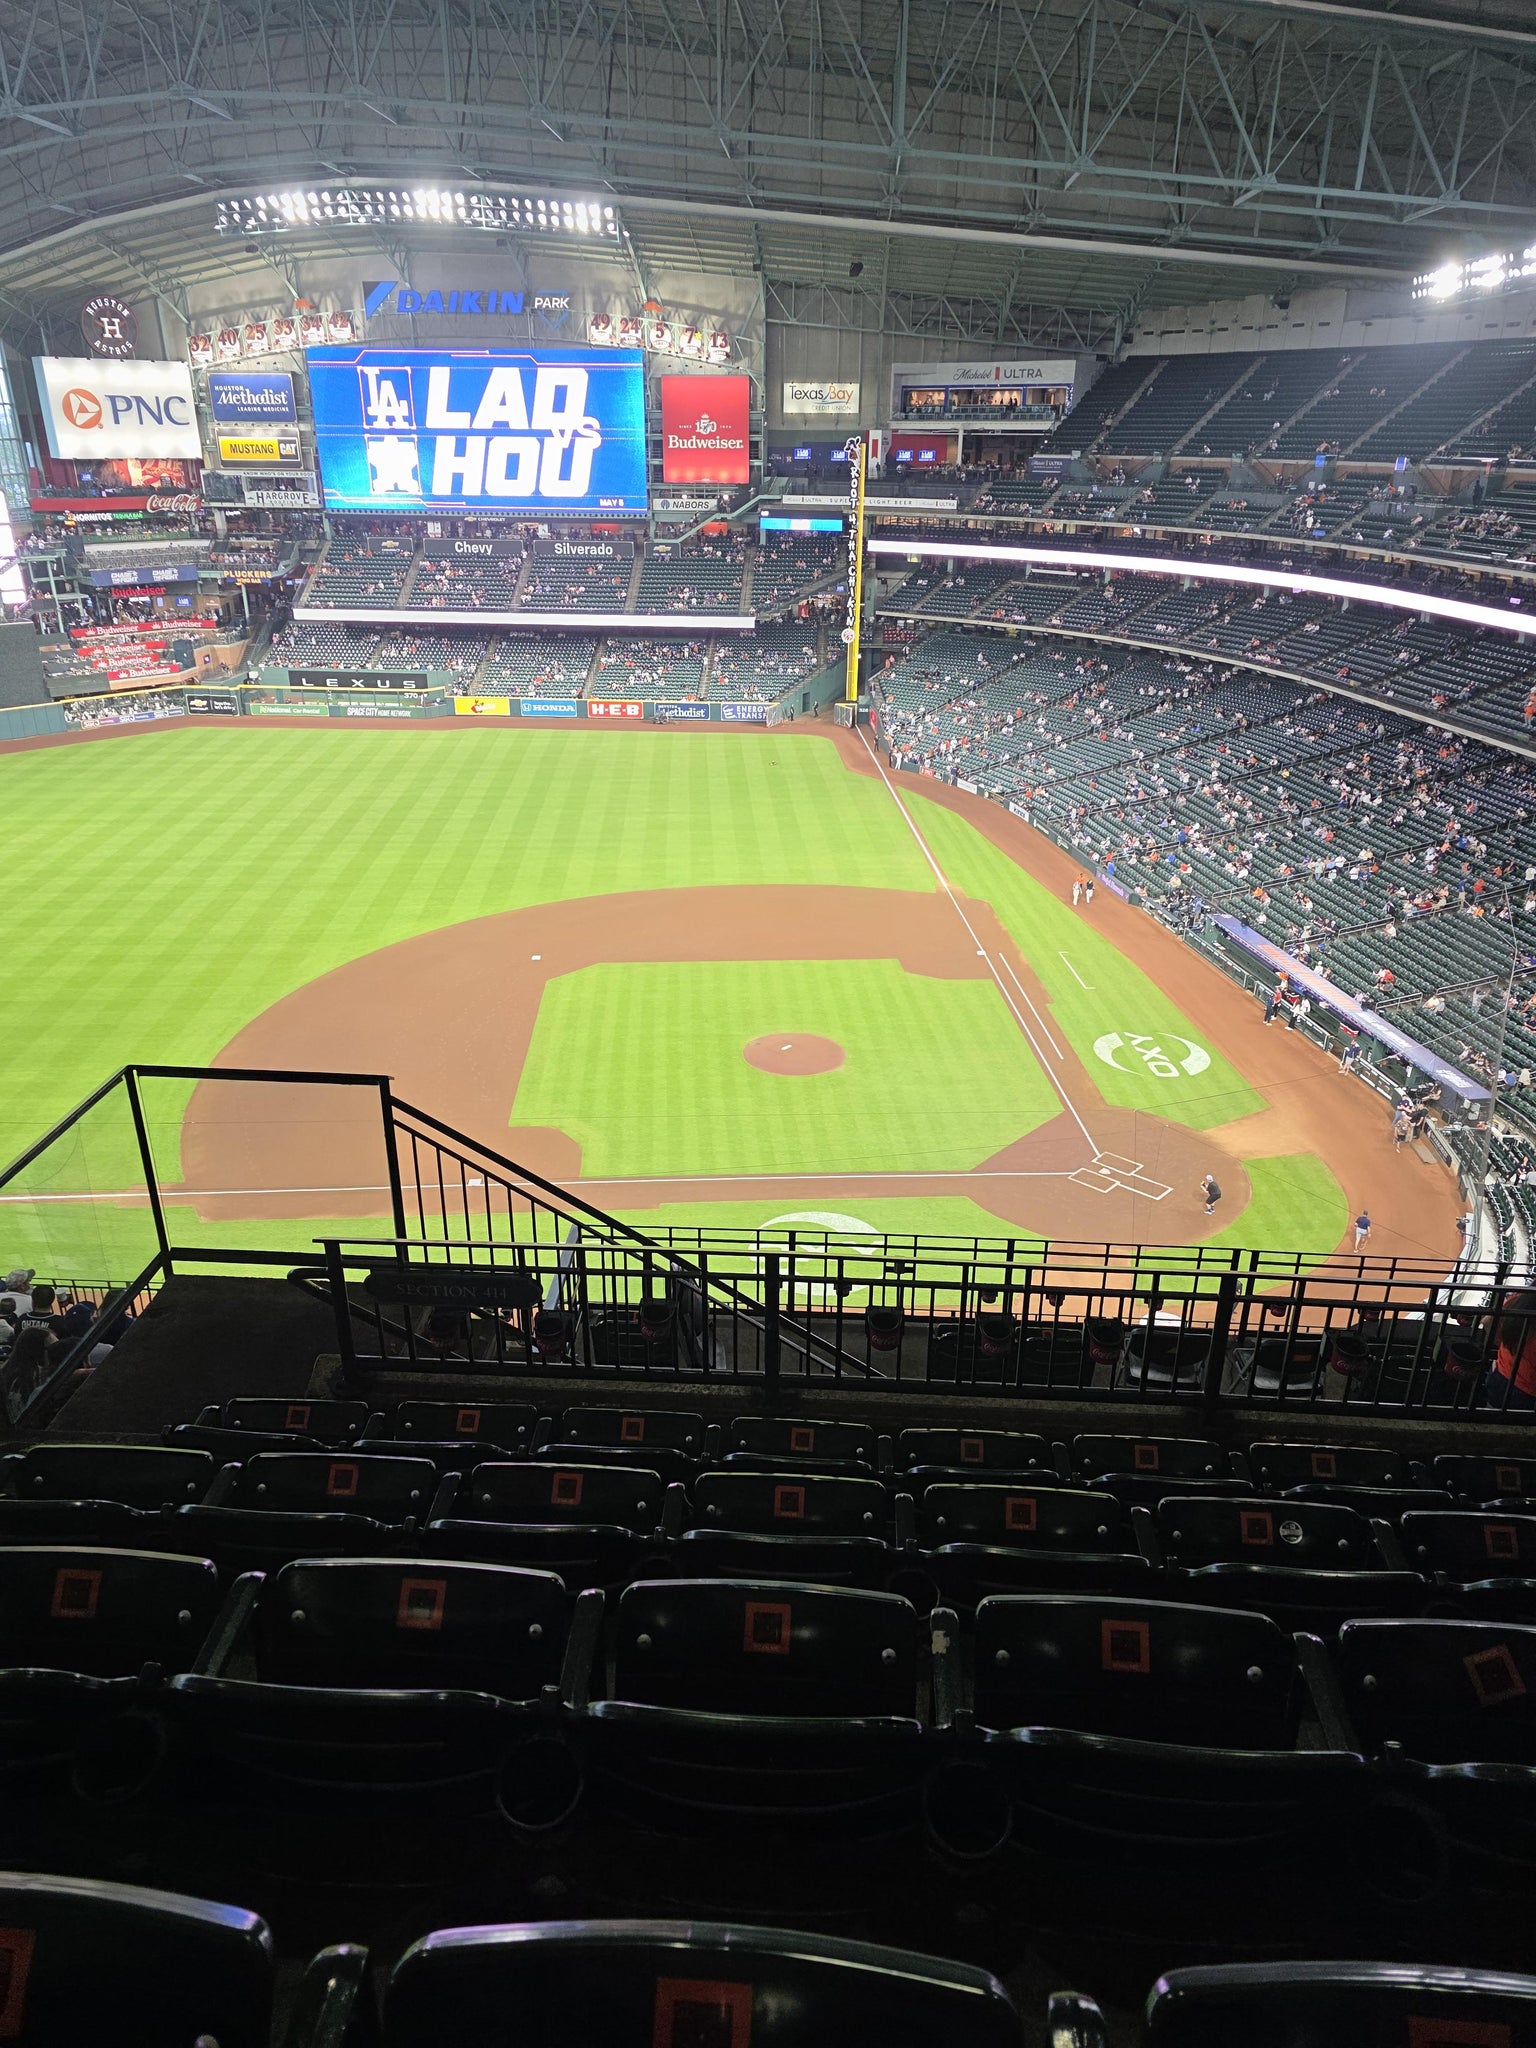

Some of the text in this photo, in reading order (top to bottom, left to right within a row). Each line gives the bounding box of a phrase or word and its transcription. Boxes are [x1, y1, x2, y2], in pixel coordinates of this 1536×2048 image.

[86, 298, 130, 317] HOUSTON
[397, 290, 570, 314] DAIKIN PARK
[100, 317, 123, 338] H
[273, 318, 294, 335] 33
[301, 315, 322, 331] 34
[329, 311, 349, 328] 42
[591, 312, 610, 330] 49
[620, 317, 640, 334] 24
[217, 329, 237, 346] 40
[245, 323, 265, 340] 25
[656, 322, 665, 339] 5
[685, 327, 695, 344] 7
[94, 340, 133, 355] ASTROS
[190, 335, 210, 352] 32
[710, 331, 729, 349] 13
[953, 368, 1043, 381] Michelob ULTRA
[217, 389, 288, 405] Methodist
[425, 367, 589, 429] LAD
[789, 385, 854, 405] Texas Bay
[105, 394, 190, 426] PNC
[229, 444, 296, 455] MUSTANG CAT
[668, 435, 743, 449] Budweiser
[432, 436, 594, 498] HOU
[146, 493, 199, 513] Coca-Cola
[256, 492, 309, 504] HARGROVE
[74, 513, 112, 521] HORNITOS
[455, 541, 493, 556] Chevy
[554, 542, 614, 556] Silverado
[846, 466, 860, 627] ROOT 4 THA CHIKIN
[224, 570, 272, 579] PLUCKERS
[110, 586, 166, 597] Budweiser
[97, 625, 138, 635] Budweiser
[162, 620, 202, 629] Budweiser
[104, 643, 147, 654] Budweiser
[108, 656, 152, 667] Budweiser
[129, 667, 171, 677] Budweiser
[302, 678, 416, 689] LEXUS
[347, 707, 365, 716] SPACE
[365, 707, 378, 716] CITY
[592, 703, 639, 716] H-E-B
[1123, 1031, 1180, 1078] OXY
[395, 1283, 507, 1299] SECTION 414
[21, 1319, 50, 1330] OHTANI
